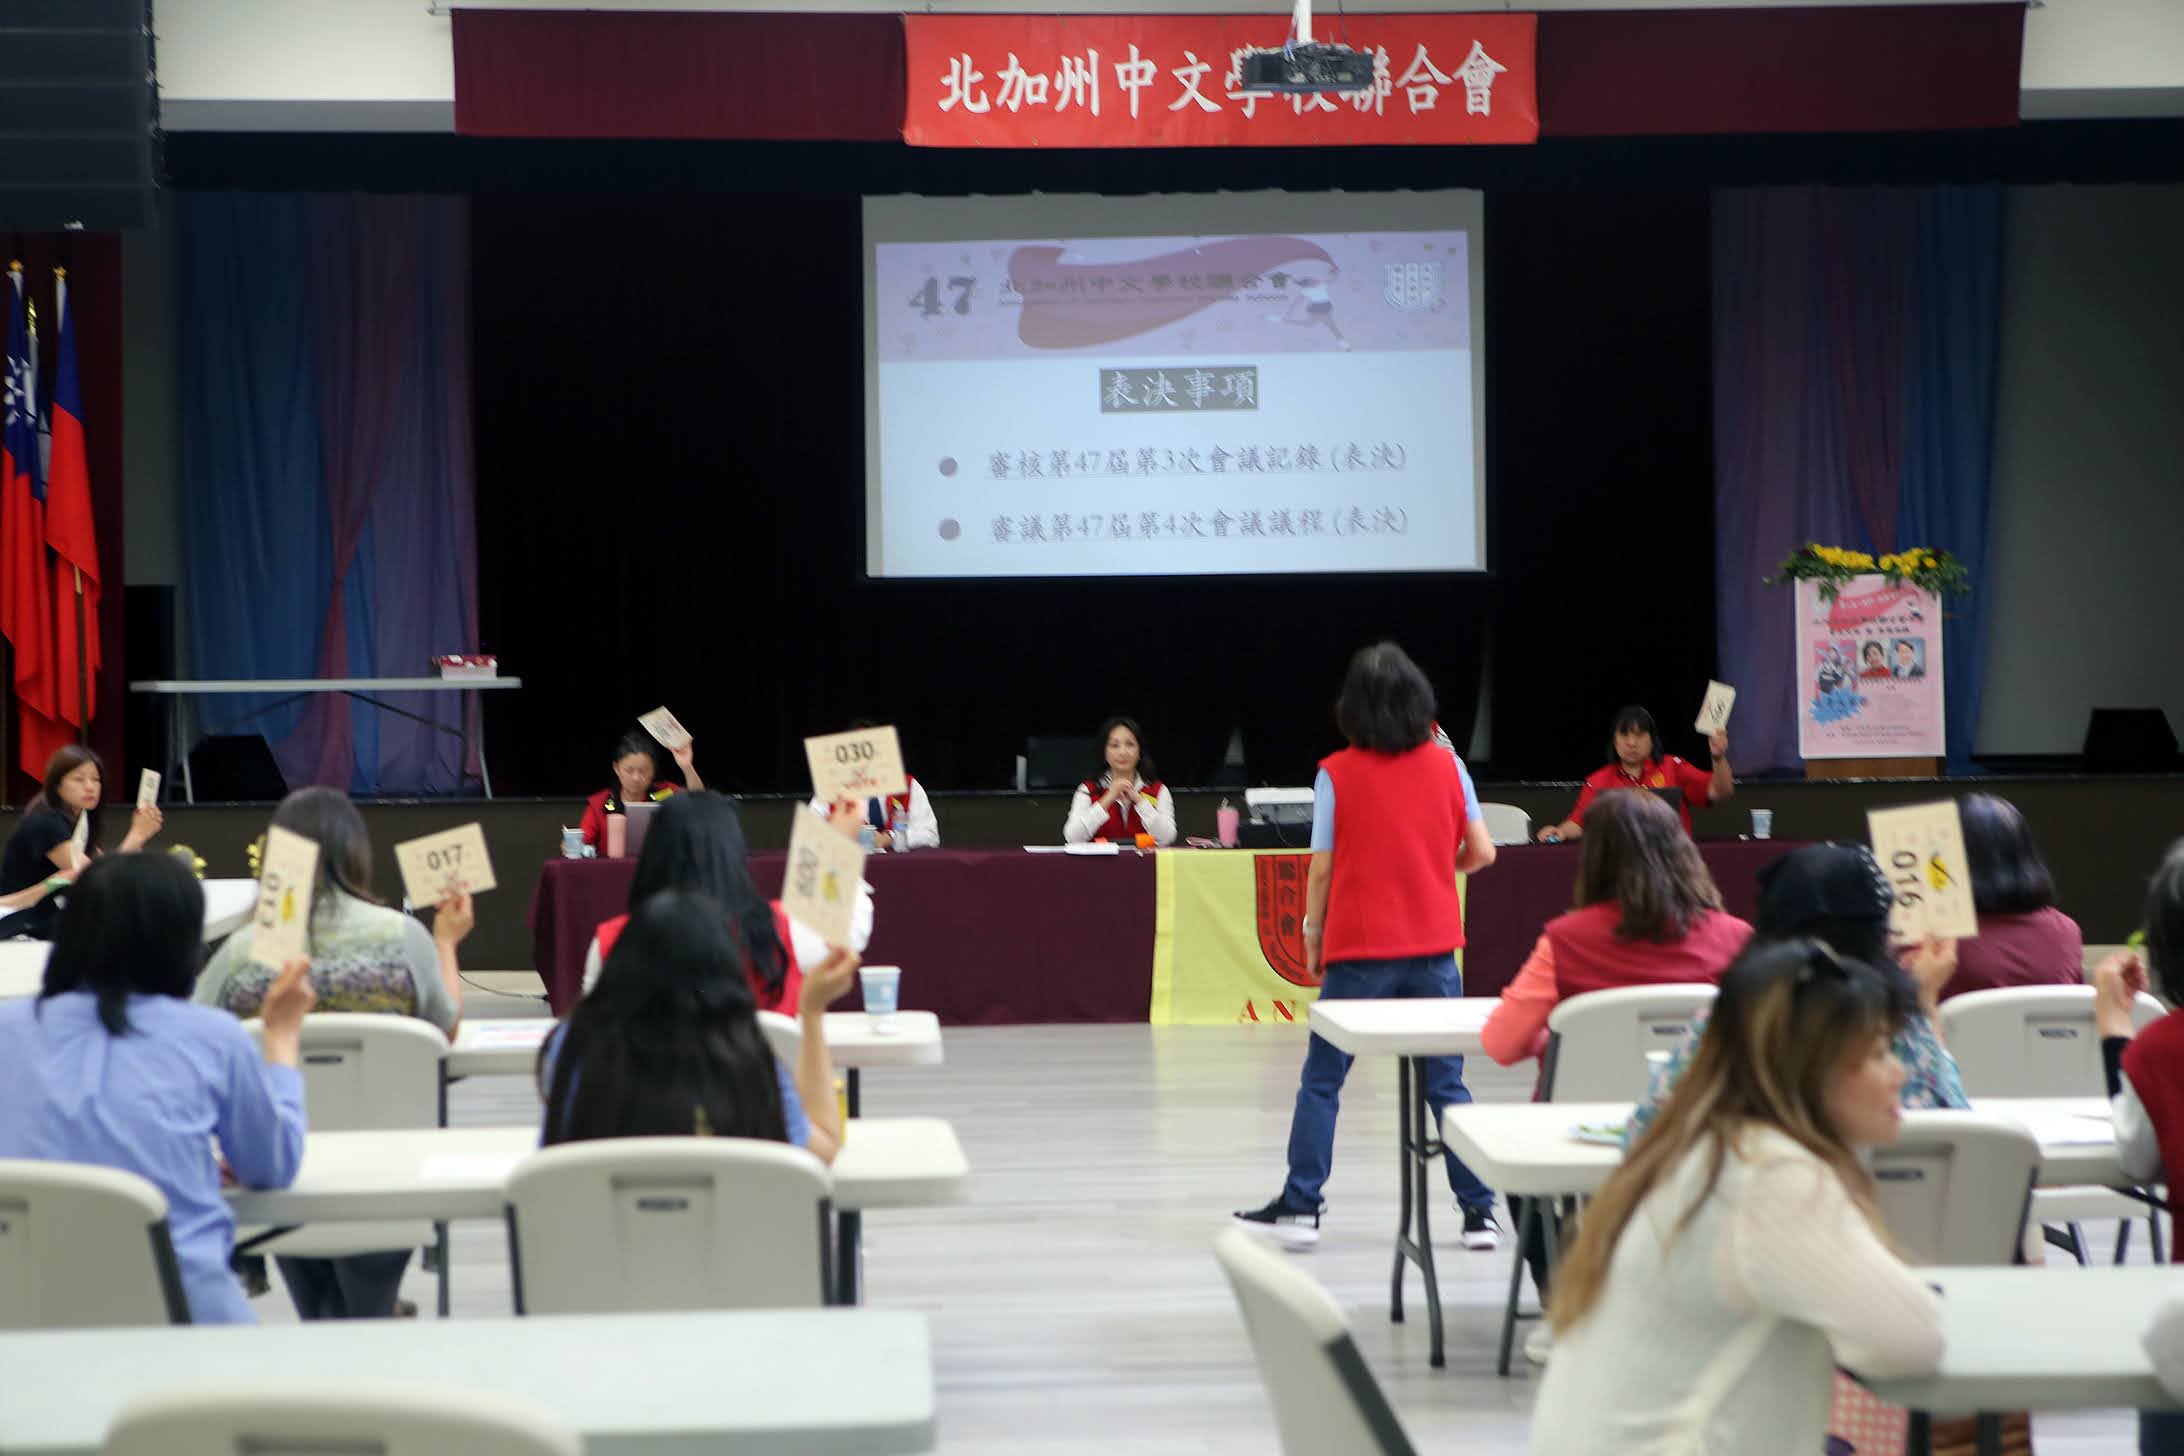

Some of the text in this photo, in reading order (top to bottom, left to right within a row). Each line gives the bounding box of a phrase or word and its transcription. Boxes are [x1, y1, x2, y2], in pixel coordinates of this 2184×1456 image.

[909, 276, 976, 316] 47
[1104, 369, 1256, 408] 表決事項
[835, 741, 874, 764] 030
[427, 845, 462, 870] 017
[1891, 850, 1924, 907] 016
